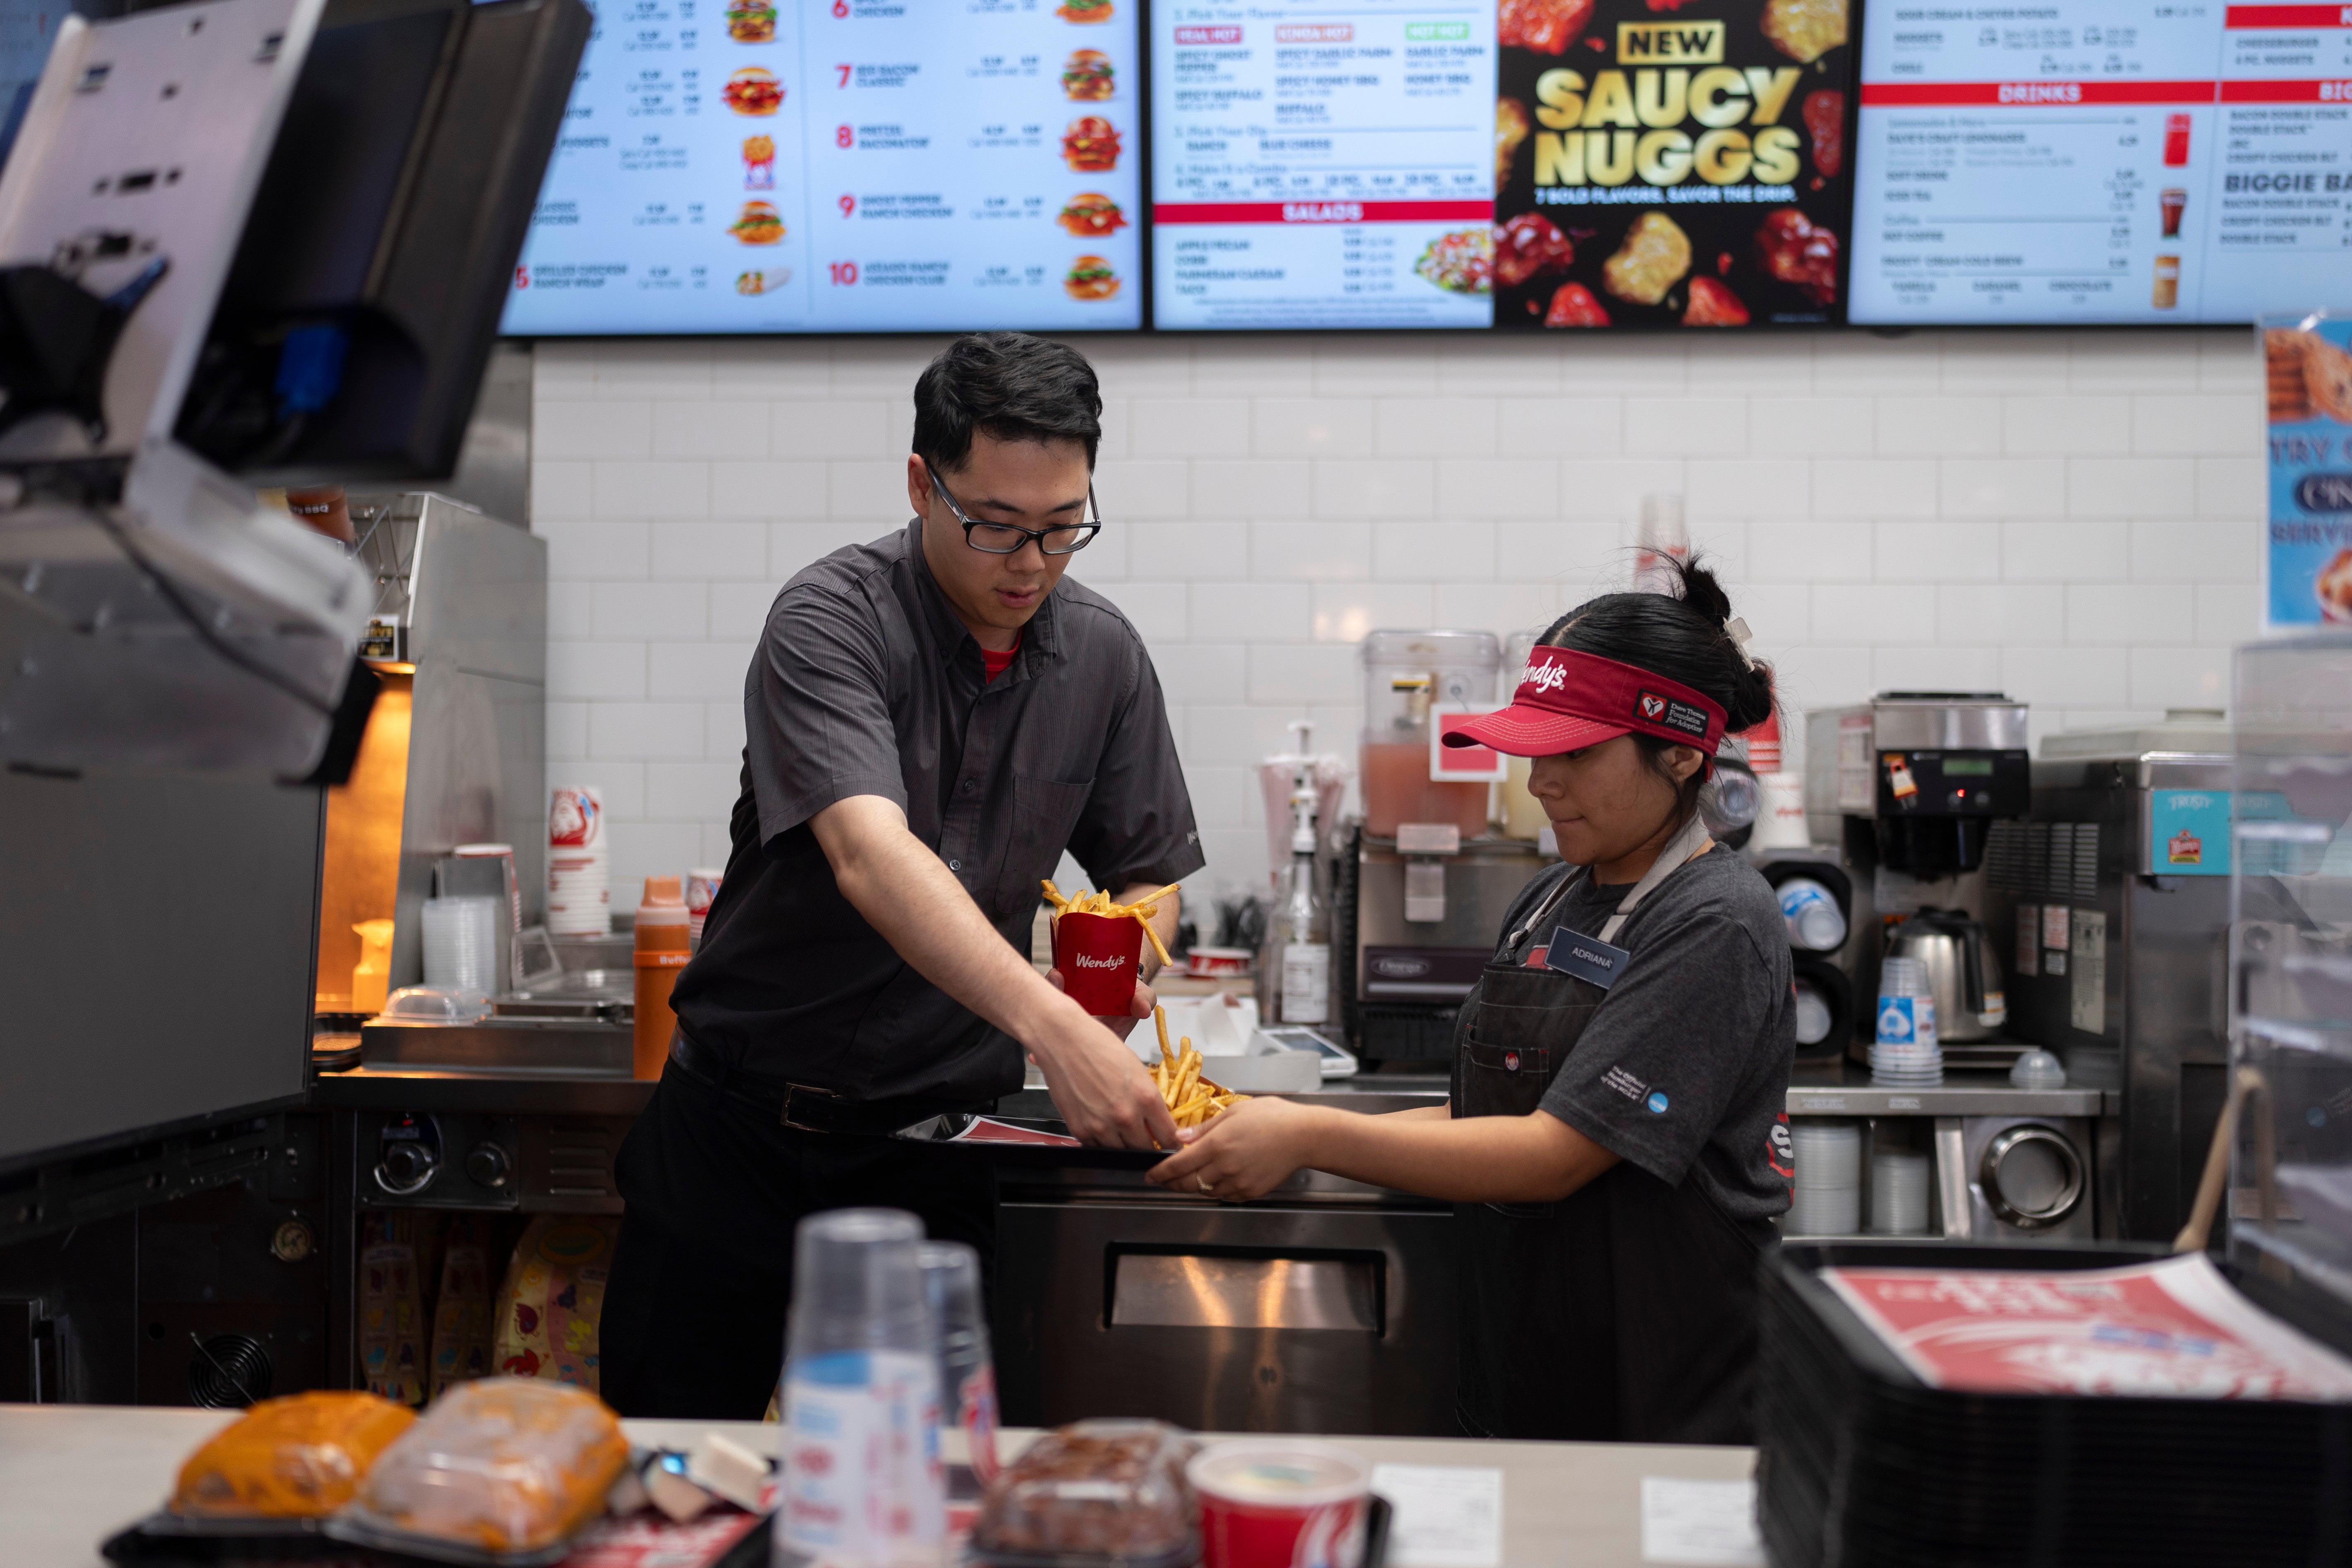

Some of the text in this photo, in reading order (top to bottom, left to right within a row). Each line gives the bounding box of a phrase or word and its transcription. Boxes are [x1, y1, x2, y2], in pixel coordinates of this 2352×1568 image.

[833, 0, 848, 18] 6
[854, 7, 904, 16] CHICKEN
[1628, 30, 1714, 55] NEW
[836, 65, 851, 87] 7
[879, 65, 918, 74] BACON
[1535, 67, 1803, 128] SAUCY
[1999, 85, 2081, 102] DRINKS
[837, 126, 852, 147] 8
[1534, 128, 1801, 186] NUGGS
[2226, 175, 2315, 191] BIGGIE
[1549, 189, 1588, 202] BOLD
[1668, 187, 1720, 201] SAVOR
[1724, 186, 1752, 201] THE
[839, 196, 854, 217] 9
[1283, 205, 1364, 220] SALADS
[829, 263, 856, 284] 10
[2271, 437, 2330, 464] TRY
[305, 503, 329, 513] BBQ
[1520, 656, 1567, 694] endy's
[1669, 709, 1700, 725] Foundation
[1671, 703, 1706, 720] Dave Thomas
[1076, 953, 1125, 970] Wendy's
[1572, 947, 1610, 968] ADRIANA
[1607, 1071, 1641, 1094] Hamburger
[1623, 1072, 1647, 1089] Official
